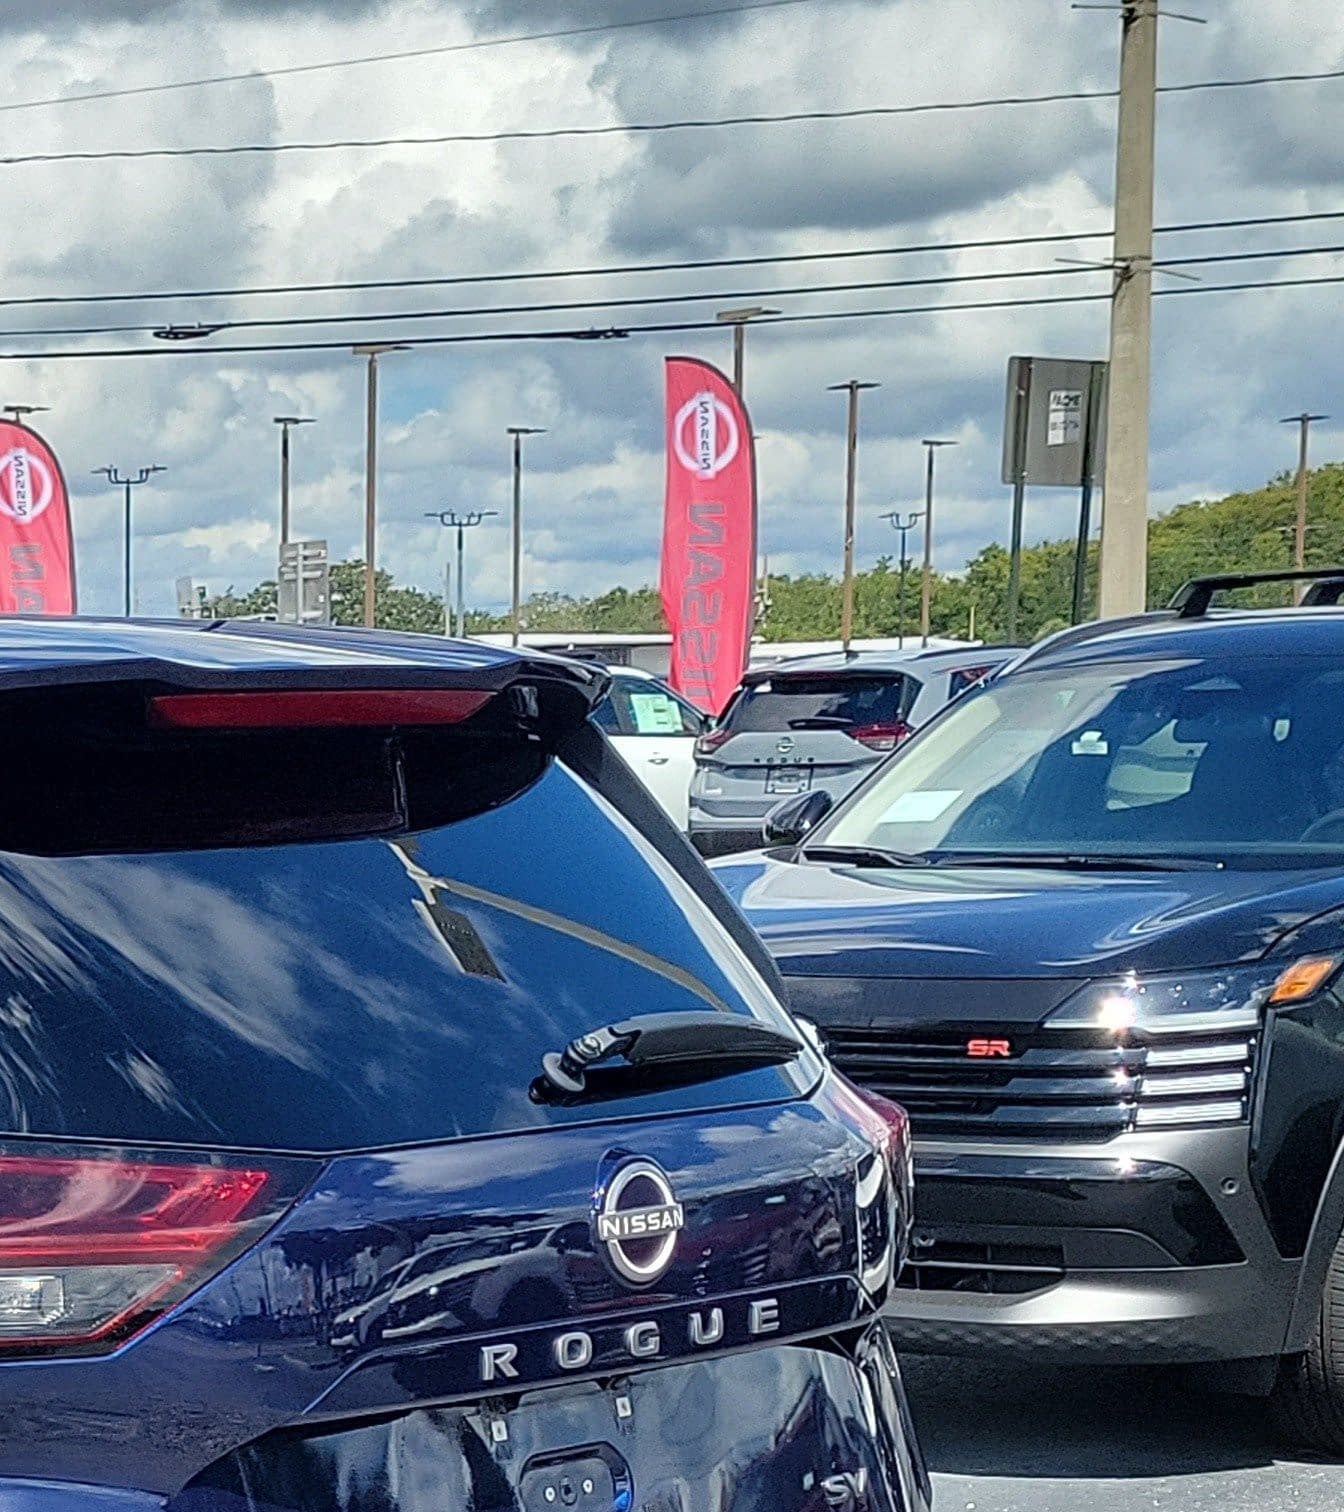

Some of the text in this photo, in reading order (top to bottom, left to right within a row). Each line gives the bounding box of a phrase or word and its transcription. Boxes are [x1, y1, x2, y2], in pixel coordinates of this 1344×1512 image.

[967, 1039, 1010, 1057] SR
[603, 1209, 684, 1237] NISSAN
[480, 1298, 781, 1381] ROGUE
[821, 1467, 868, 1505] SV
